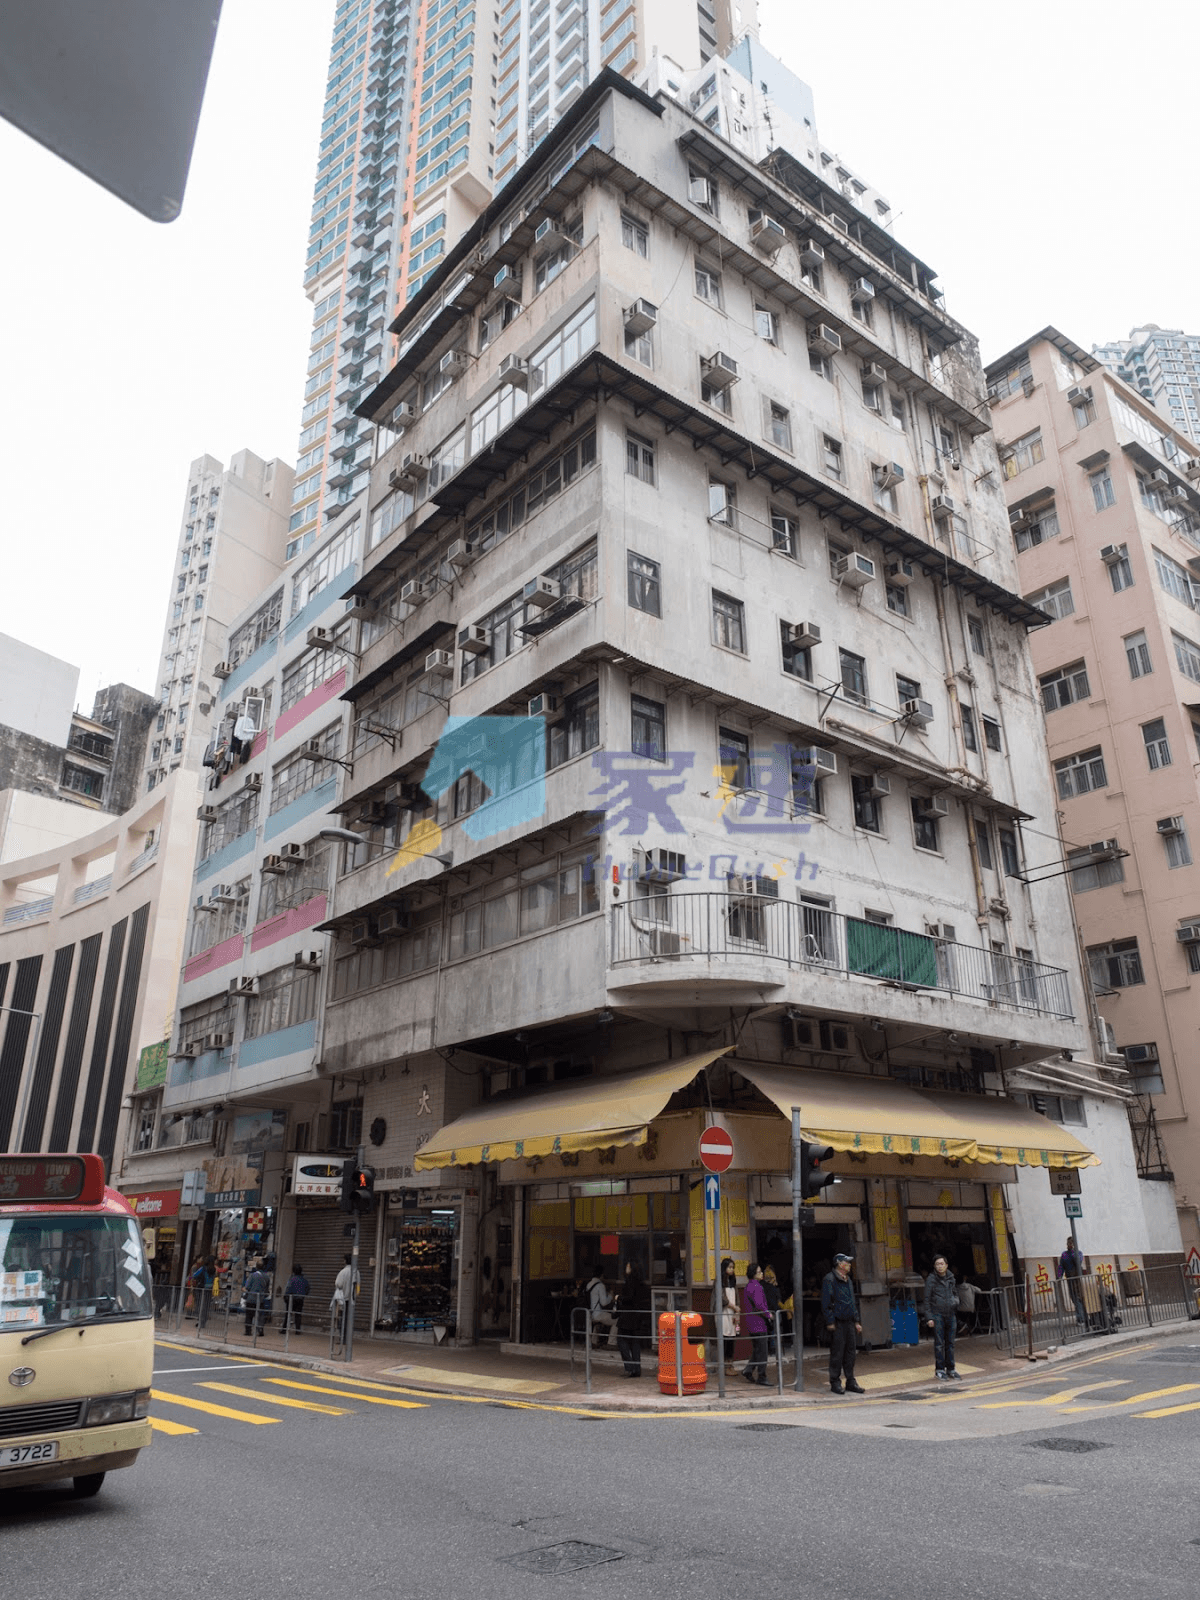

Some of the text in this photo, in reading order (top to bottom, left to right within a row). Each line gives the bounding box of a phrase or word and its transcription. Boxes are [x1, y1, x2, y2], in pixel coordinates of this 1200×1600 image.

[45, 1163, 71, 1176] TOWN
[1056, 1183, 1075, 1192] 終止
[10, 1444, 53, 1463] 3722
